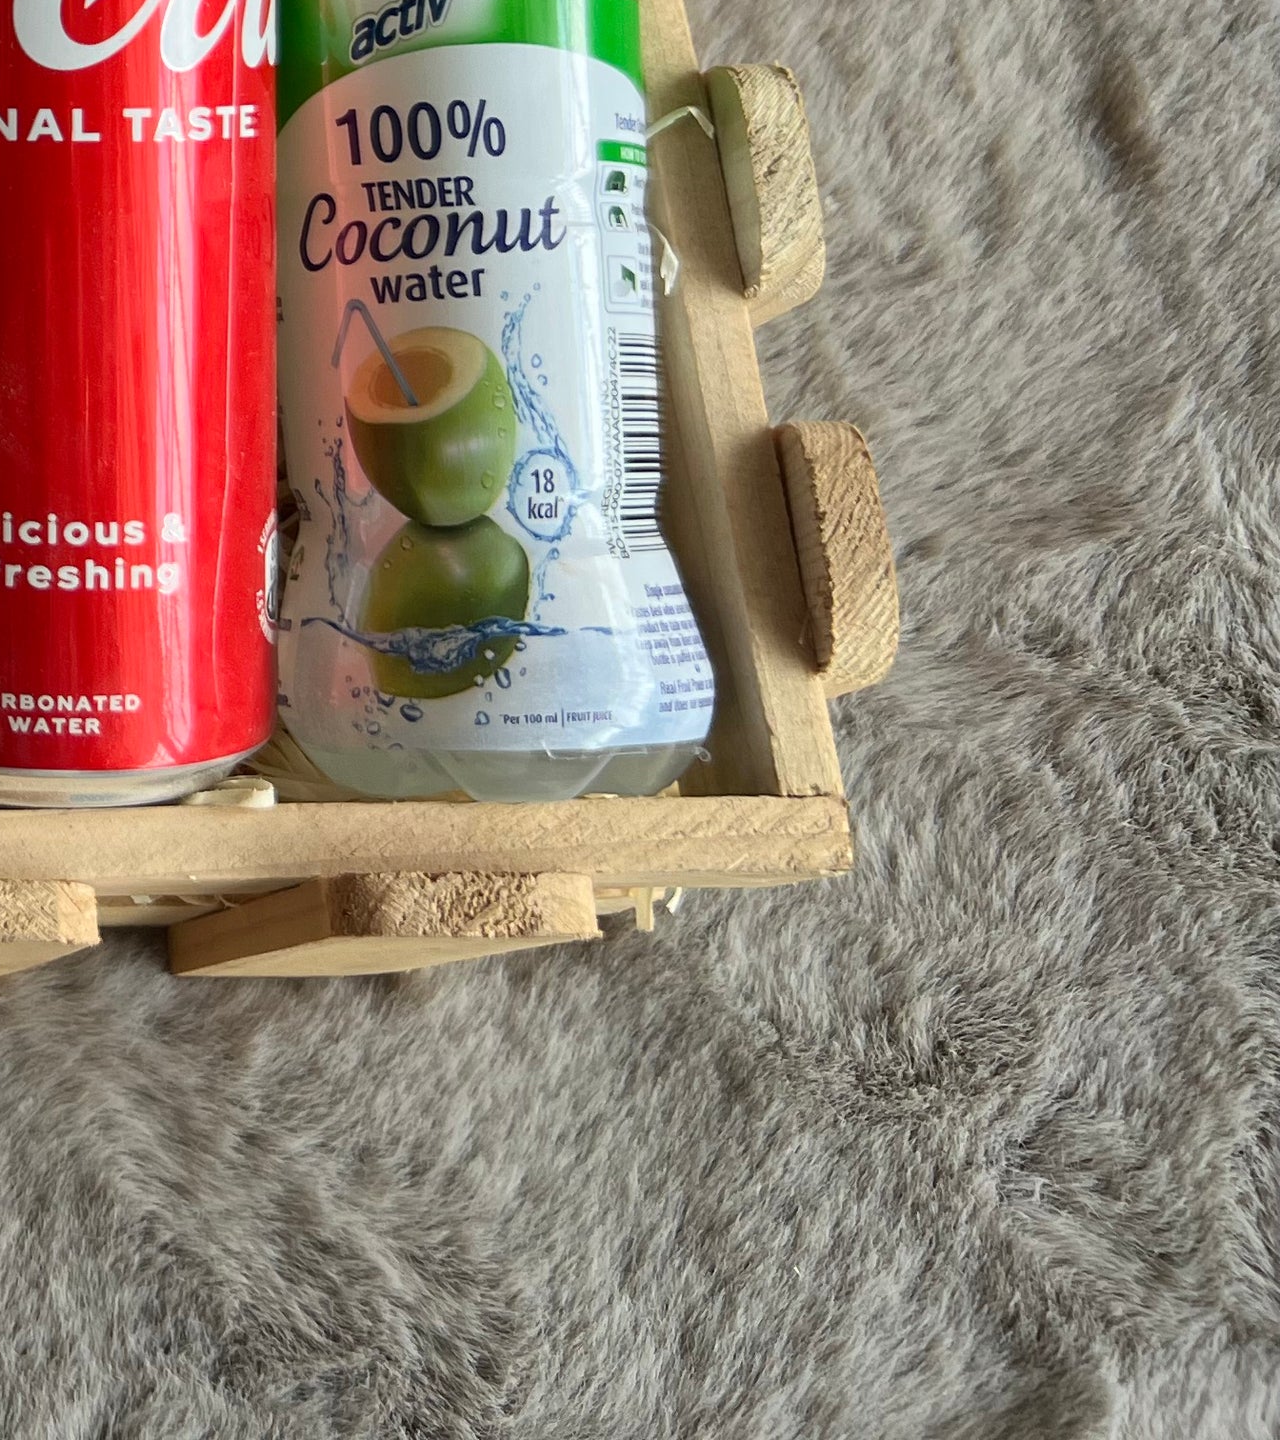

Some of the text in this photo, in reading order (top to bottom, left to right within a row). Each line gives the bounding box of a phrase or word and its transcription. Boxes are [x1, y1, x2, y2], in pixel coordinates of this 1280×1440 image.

[122, 104, 259, 143] TASTE
[335, 99, 507, 167] 100%
[362, 175, 474, 213] TENDER
[299, 192, 567, 273] Coconut
[370, 265, 485, 305] water
[530, 468, 555, 494] 18
[160, 511, 187, 543] &
[7, 716, 101, 736] WATER
[524, 712, 542, 724] 100
[544, 713, 558, 724] ml
[566, 710, 613, 723] FRUIT JUICE
